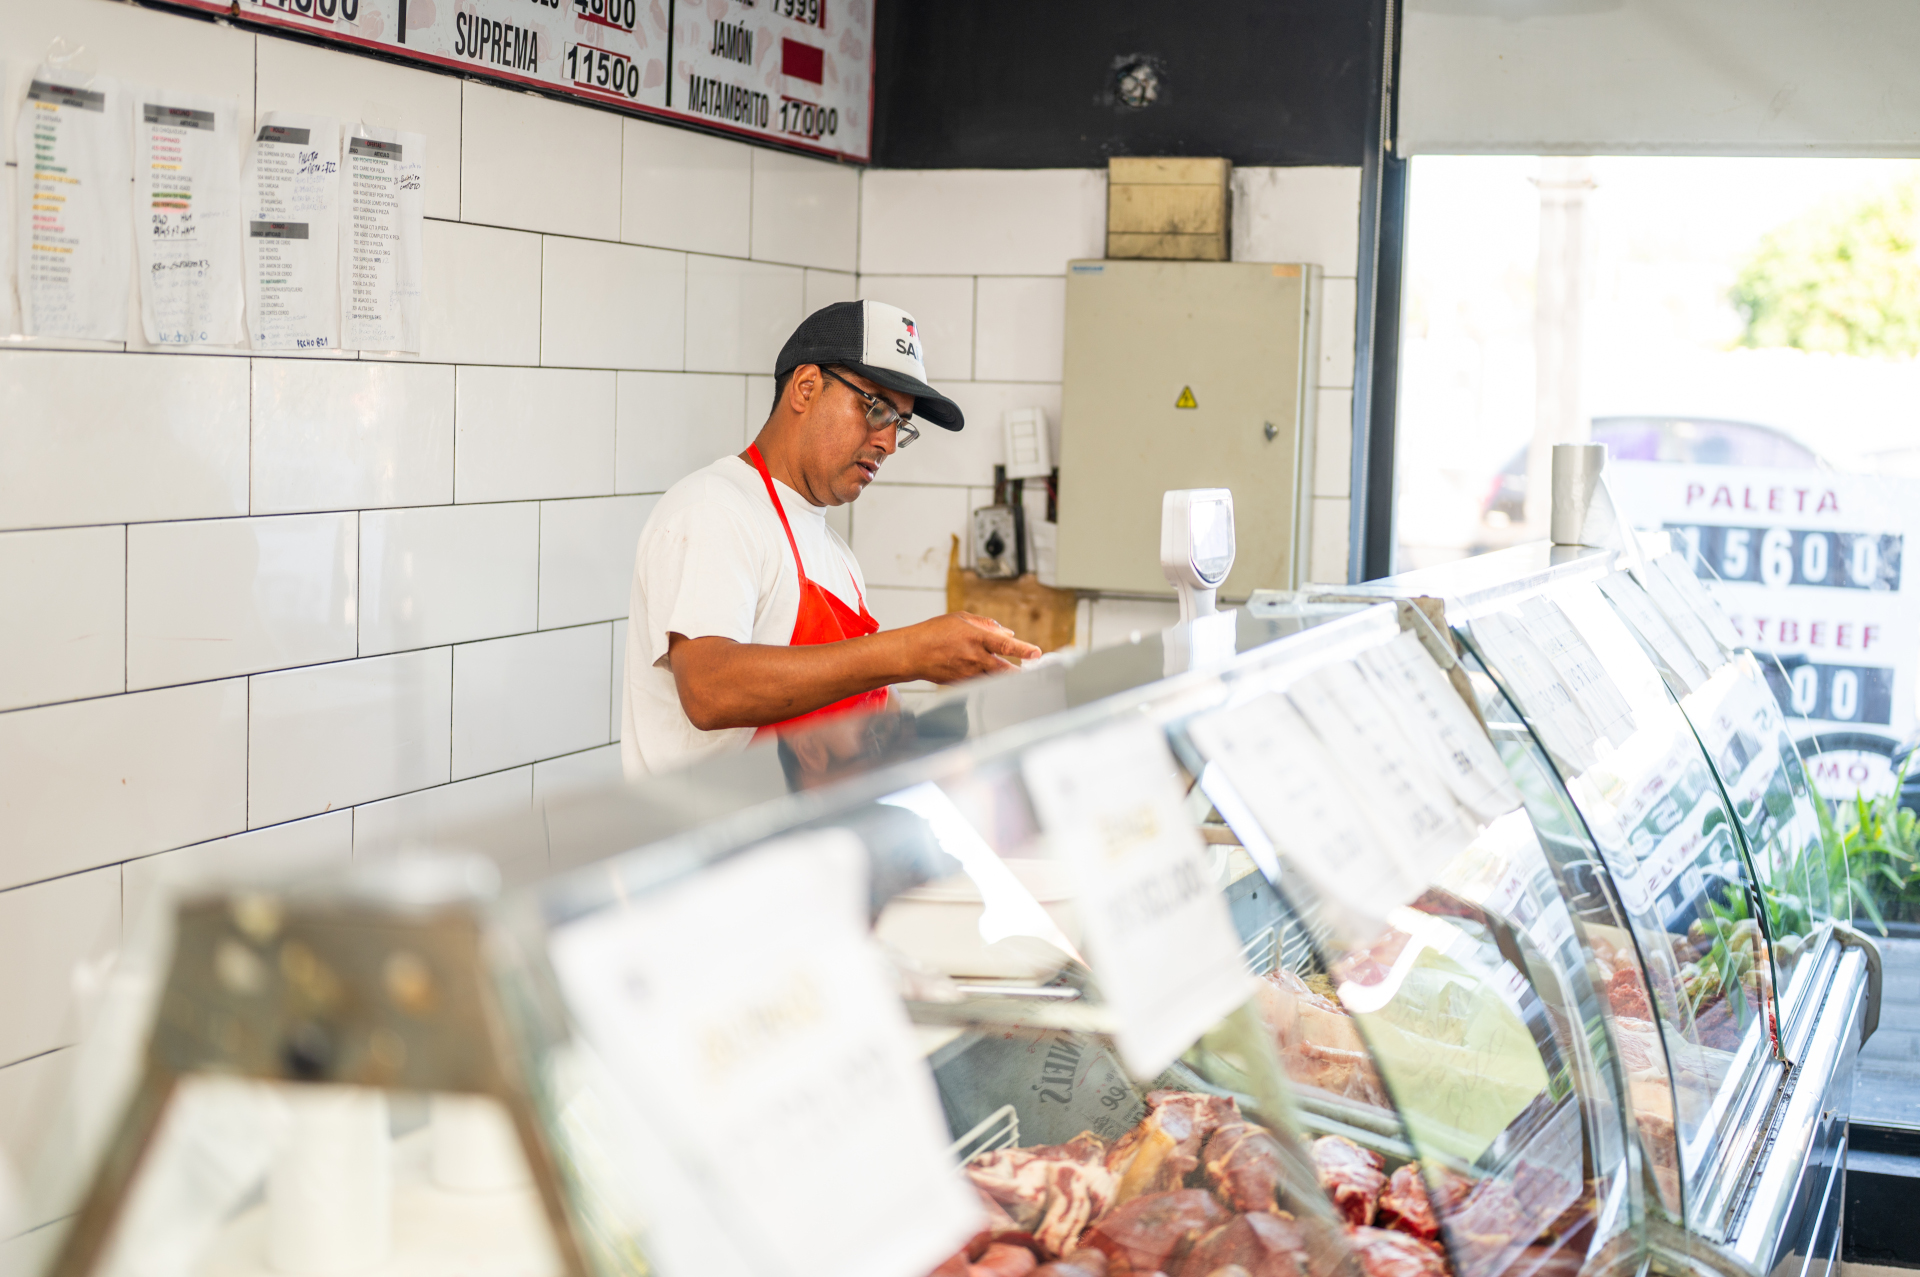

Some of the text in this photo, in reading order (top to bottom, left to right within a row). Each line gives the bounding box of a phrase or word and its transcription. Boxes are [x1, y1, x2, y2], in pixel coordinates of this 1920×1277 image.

[455, 11, 640, 98] SUPREMA 11500
[711, 19, 753, 66] JAMÓN
[688, 74, 839, 136] MATAMBRITO 17000
[896, 338, 919, 361] SA
[1686, 483, 1841, 514] PALETA
